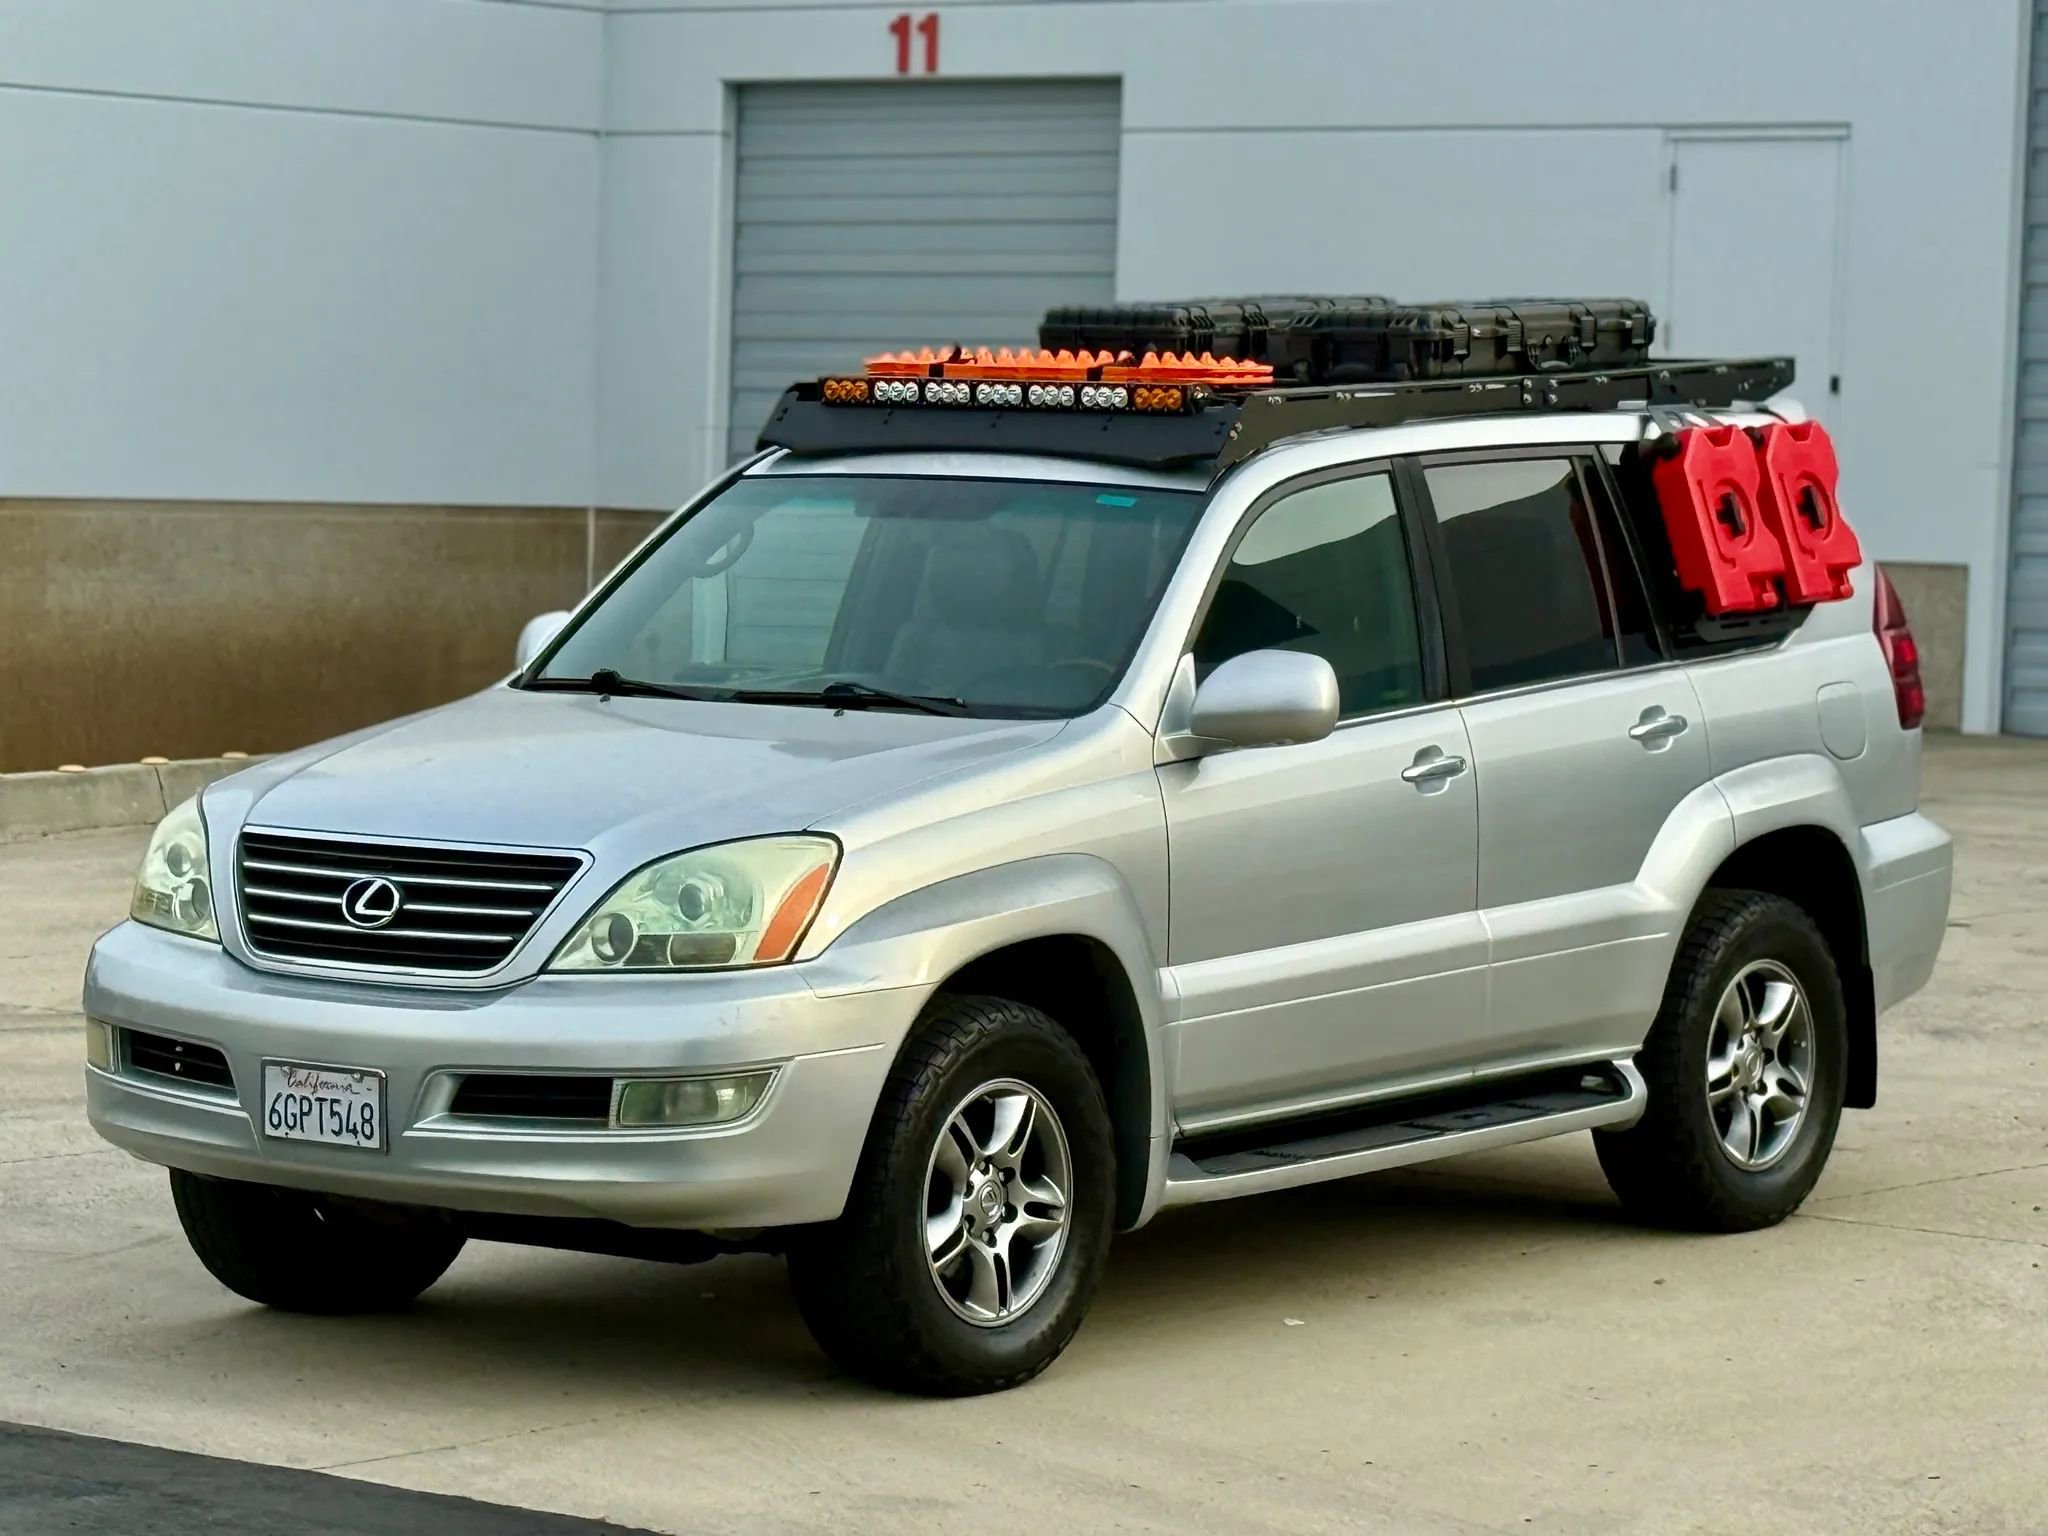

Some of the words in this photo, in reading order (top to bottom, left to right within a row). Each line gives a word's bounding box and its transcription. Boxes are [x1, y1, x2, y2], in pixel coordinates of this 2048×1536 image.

[888, 13, 938, 73] 11
[286, 1068, 361, 1095] California
[269, 1092, 374, 1140] 6GPT548
